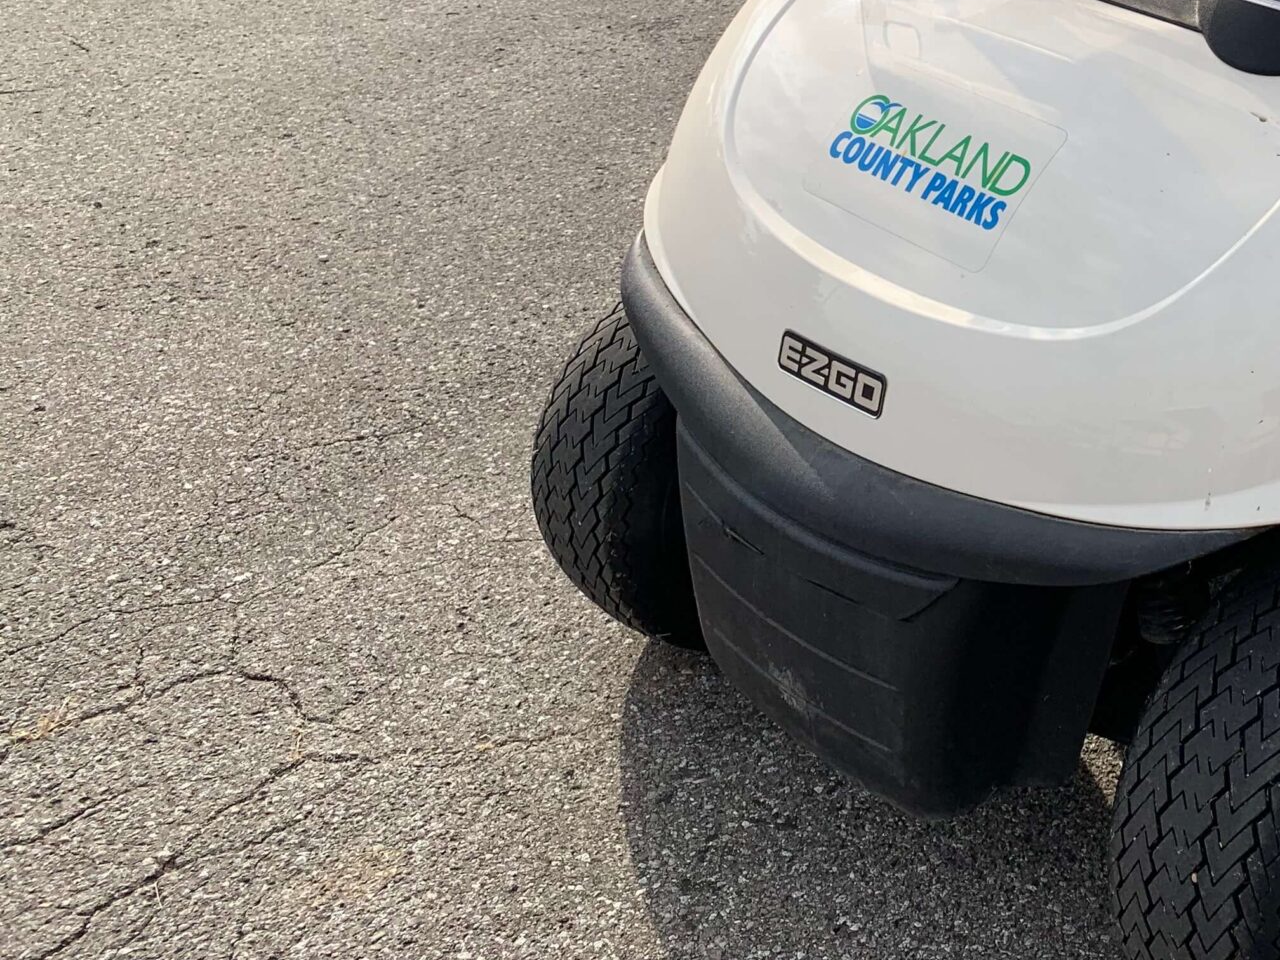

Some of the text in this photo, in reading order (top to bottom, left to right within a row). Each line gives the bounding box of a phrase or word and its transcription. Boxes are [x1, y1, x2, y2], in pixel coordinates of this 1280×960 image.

[829, 130, 1007, 231] COUNTY PARKS
[850, 94, 1031, 197] OAKLAND
[779, 335, 883, 413] EZGO
